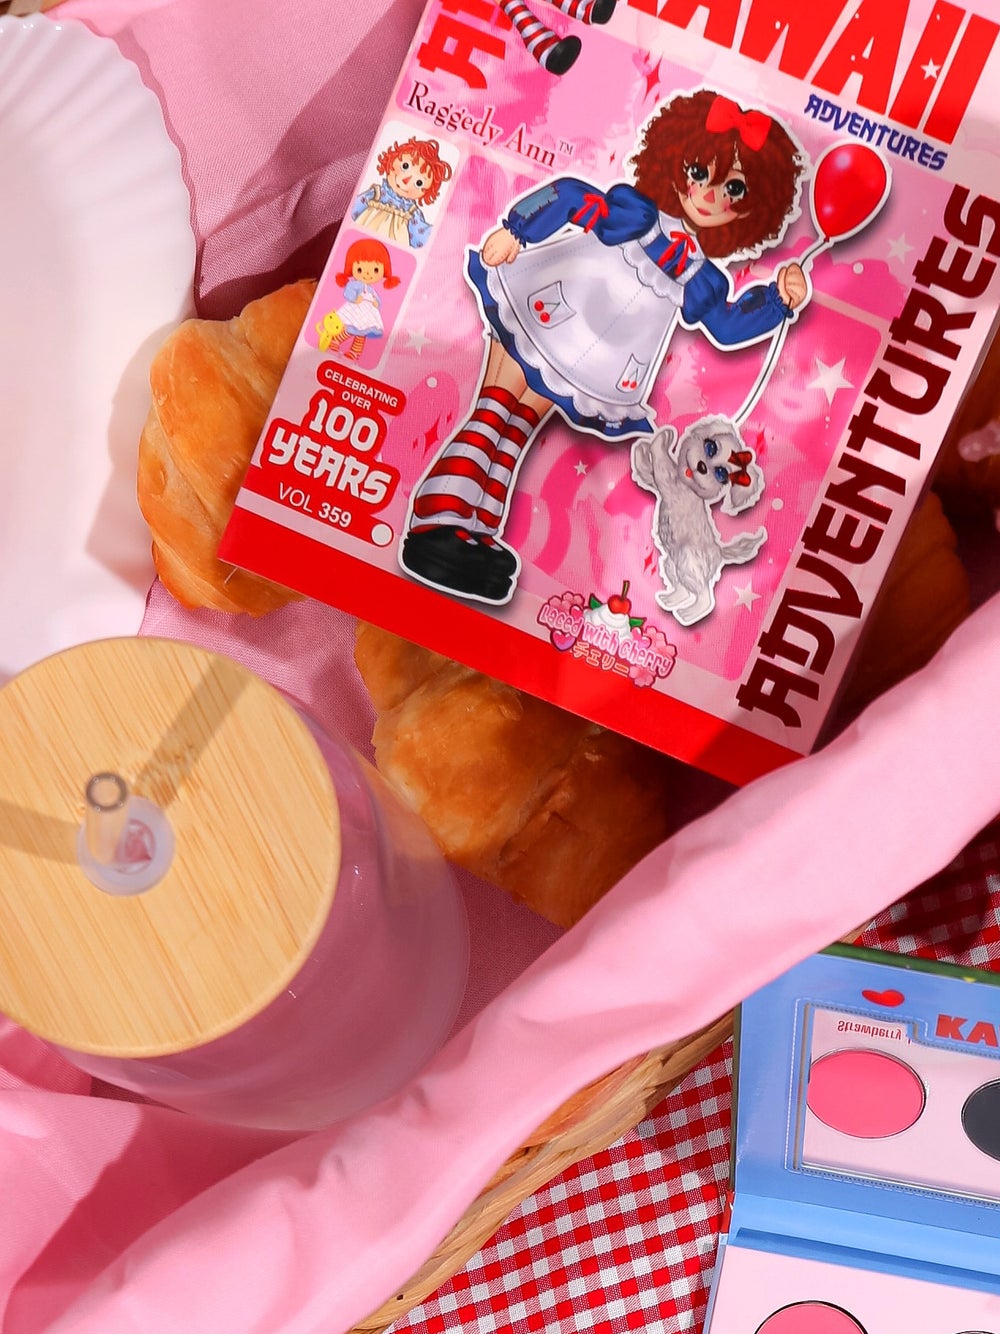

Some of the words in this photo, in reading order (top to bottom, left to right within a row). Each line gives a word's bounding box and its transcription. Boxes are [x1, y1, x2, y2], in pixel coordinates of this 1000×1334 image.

[407, 80, 501, 145] Raggedy
[804, 94, 948, 171] ADVENTURES
[325, 369, 398, 408] CELEBRATING
[342, 391, 371, 411] OVER
[309, 398, 379, 452] 100
[269, 427, 392, 504] YEARS
[279, 482, 313, 513] VOL
[319, 502, 351, 528] 359
[582, 622, 619, 651] with
